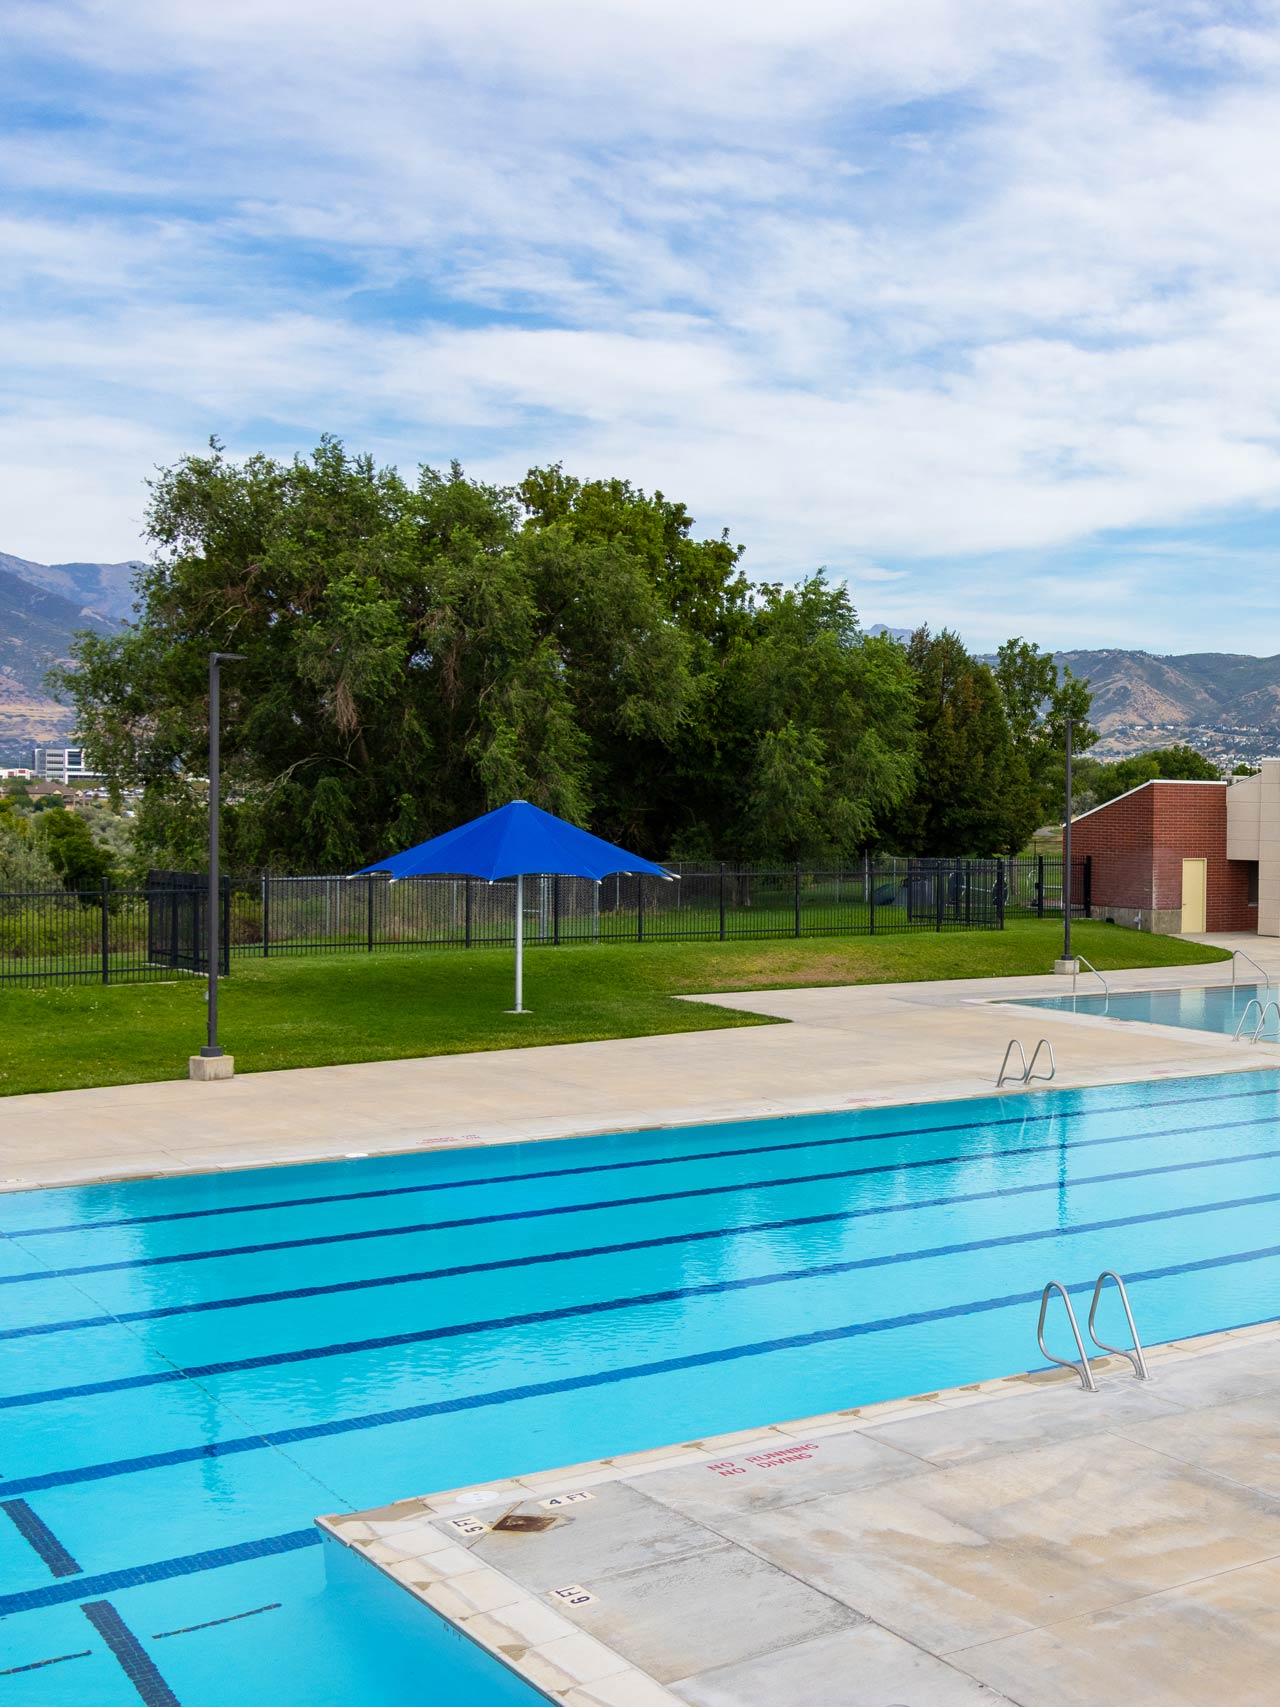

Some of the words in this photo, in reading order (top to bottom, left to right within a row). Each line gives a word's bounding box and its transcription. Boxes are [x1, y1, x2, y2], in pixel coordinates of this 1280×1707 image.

[706, 1462, 736, 1471] NO
[745, 1443, 820, 1463] RUNNING
[718, 1467, 747, 1477] NO
[756, 1452, 813, 1469] DIVING
[548, 1498, 563, 1507] 4
[566, 1491, 588, 1503] FT
[451, 1517, 477, 1528] FT
[464, 1526, 484, 1534] 5
[554, 1586, 583, 1598] FT
[570, 1596, 591, 1605] 6
